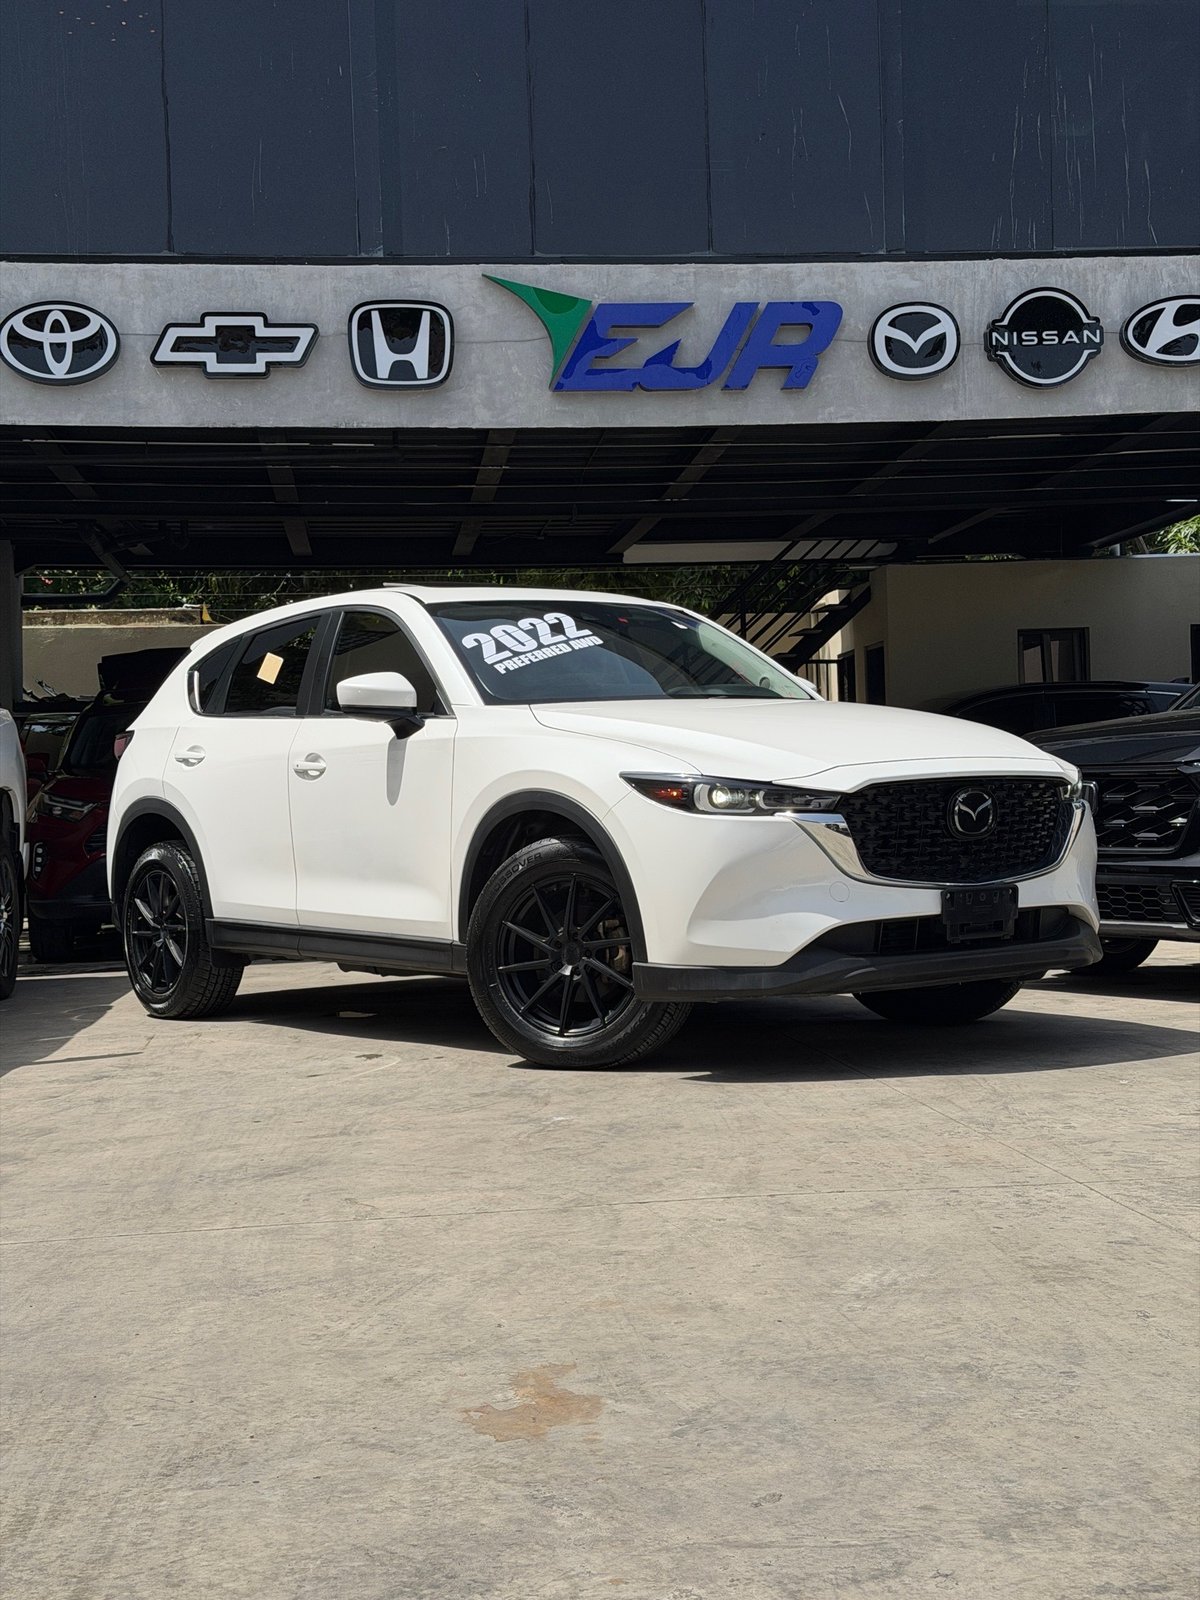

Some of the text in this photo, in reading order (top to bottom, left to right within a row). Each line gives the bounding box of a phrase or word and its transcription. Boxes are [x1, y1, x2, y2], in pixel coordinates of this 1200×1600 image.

[552, 301, 843, 392] EJR
[992, 330, 1100, 346] NISSAN
[461, 612, 593, 665] 2022
[493, 636, 604, 675] PREFERRED AWD
